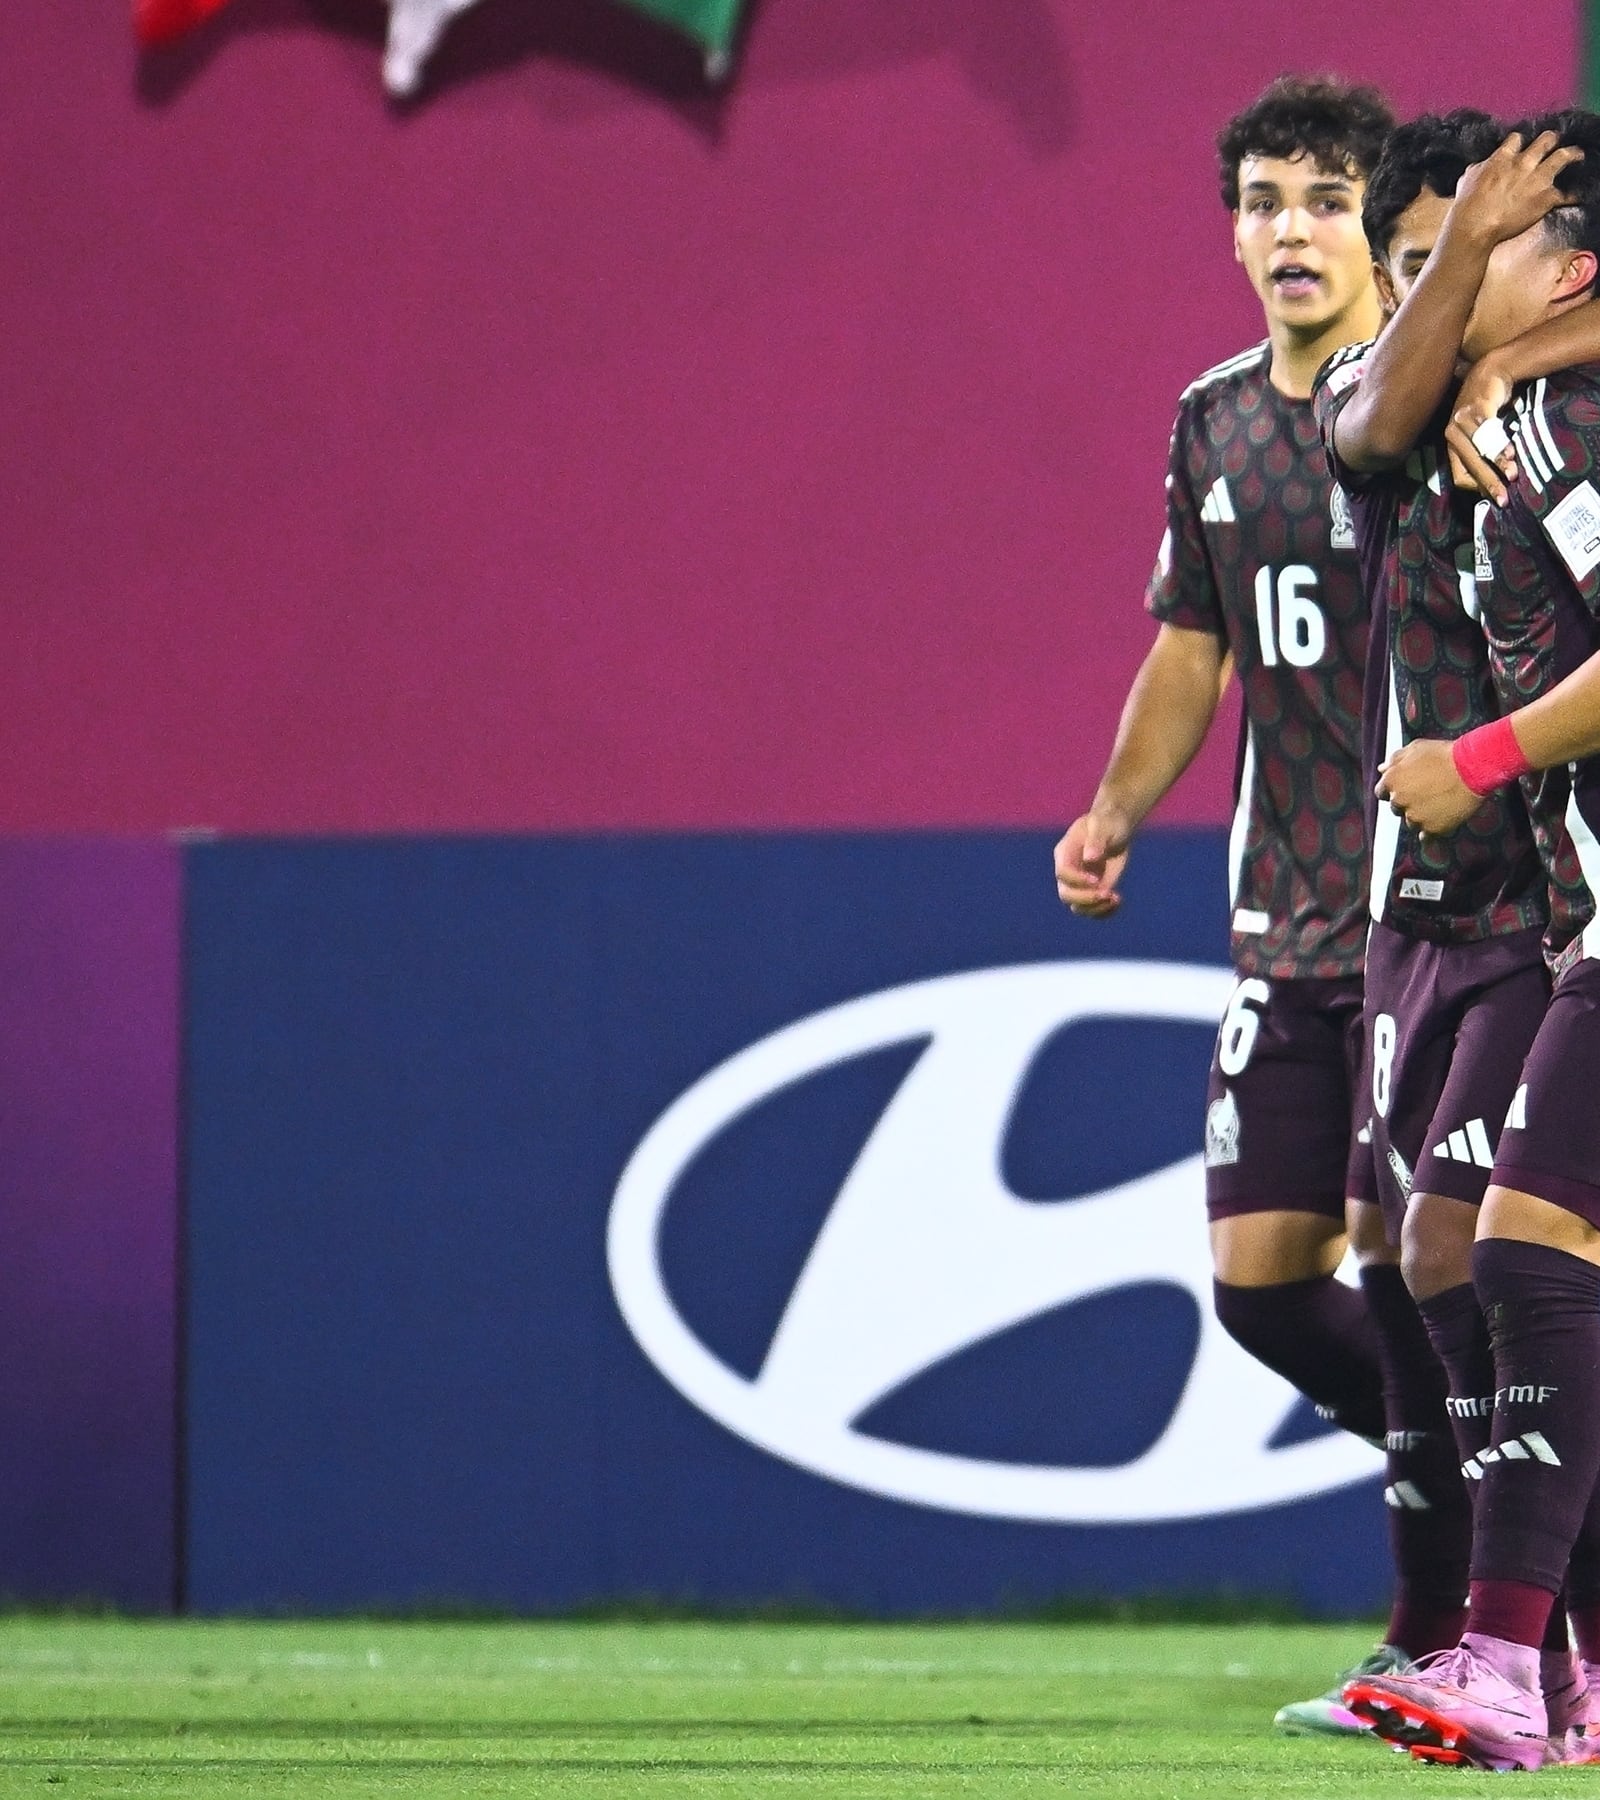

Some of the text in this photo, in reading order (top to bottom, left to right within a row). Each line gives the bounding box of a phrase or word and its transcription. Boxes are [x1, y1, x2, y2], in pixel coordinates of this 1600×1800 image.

[1564, 509, 1595, 540] UNITES
[1254, 565, 1326, 667] 16
[1494, 1385, 1559, 1409] FMF
